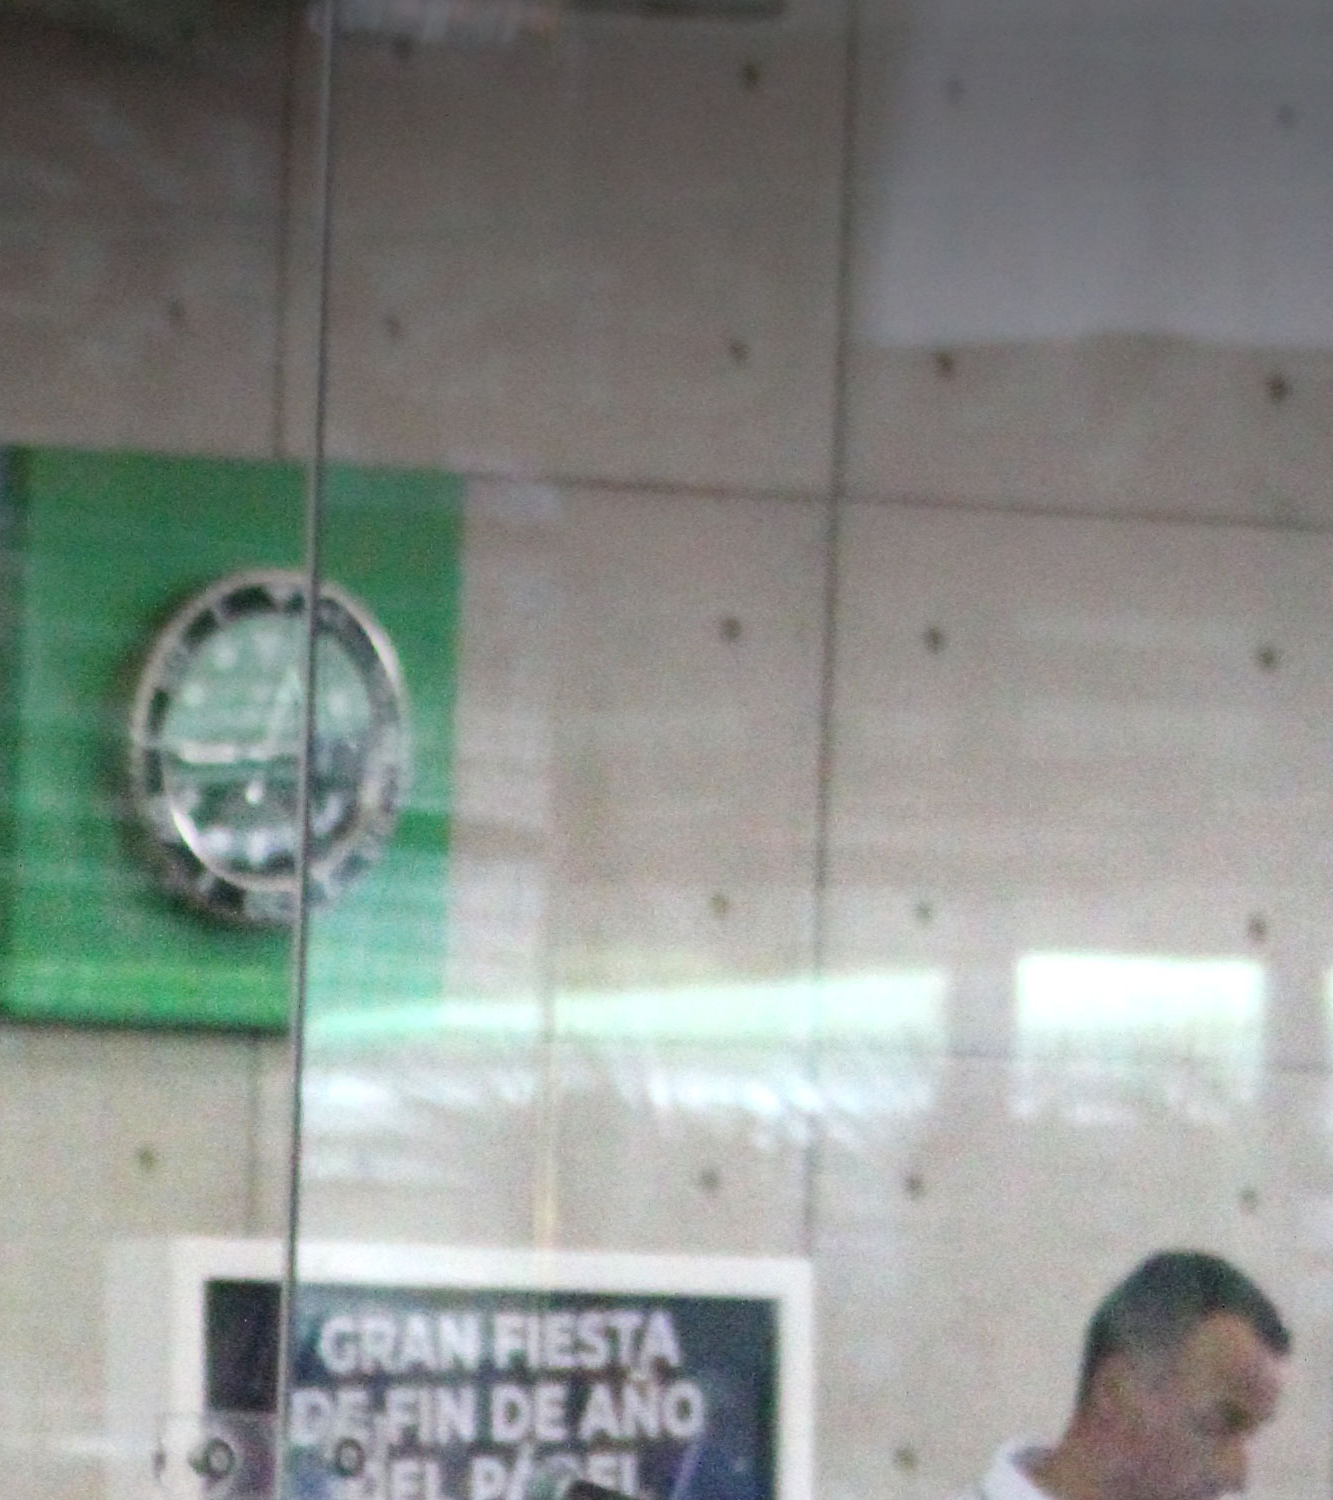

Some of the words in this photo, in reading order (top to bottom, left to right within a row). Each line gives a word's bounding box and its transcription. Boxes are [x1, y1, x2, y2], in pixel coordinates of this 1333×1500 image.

[320, 1311, 481, 1373] GRAN
[494, 1310, 682, 1368] FIESTA
[290, 1388, 370, 1445] DE
[386, 1386, 477, 1444] FIN
[492, 1383, 569, 1442] DE
